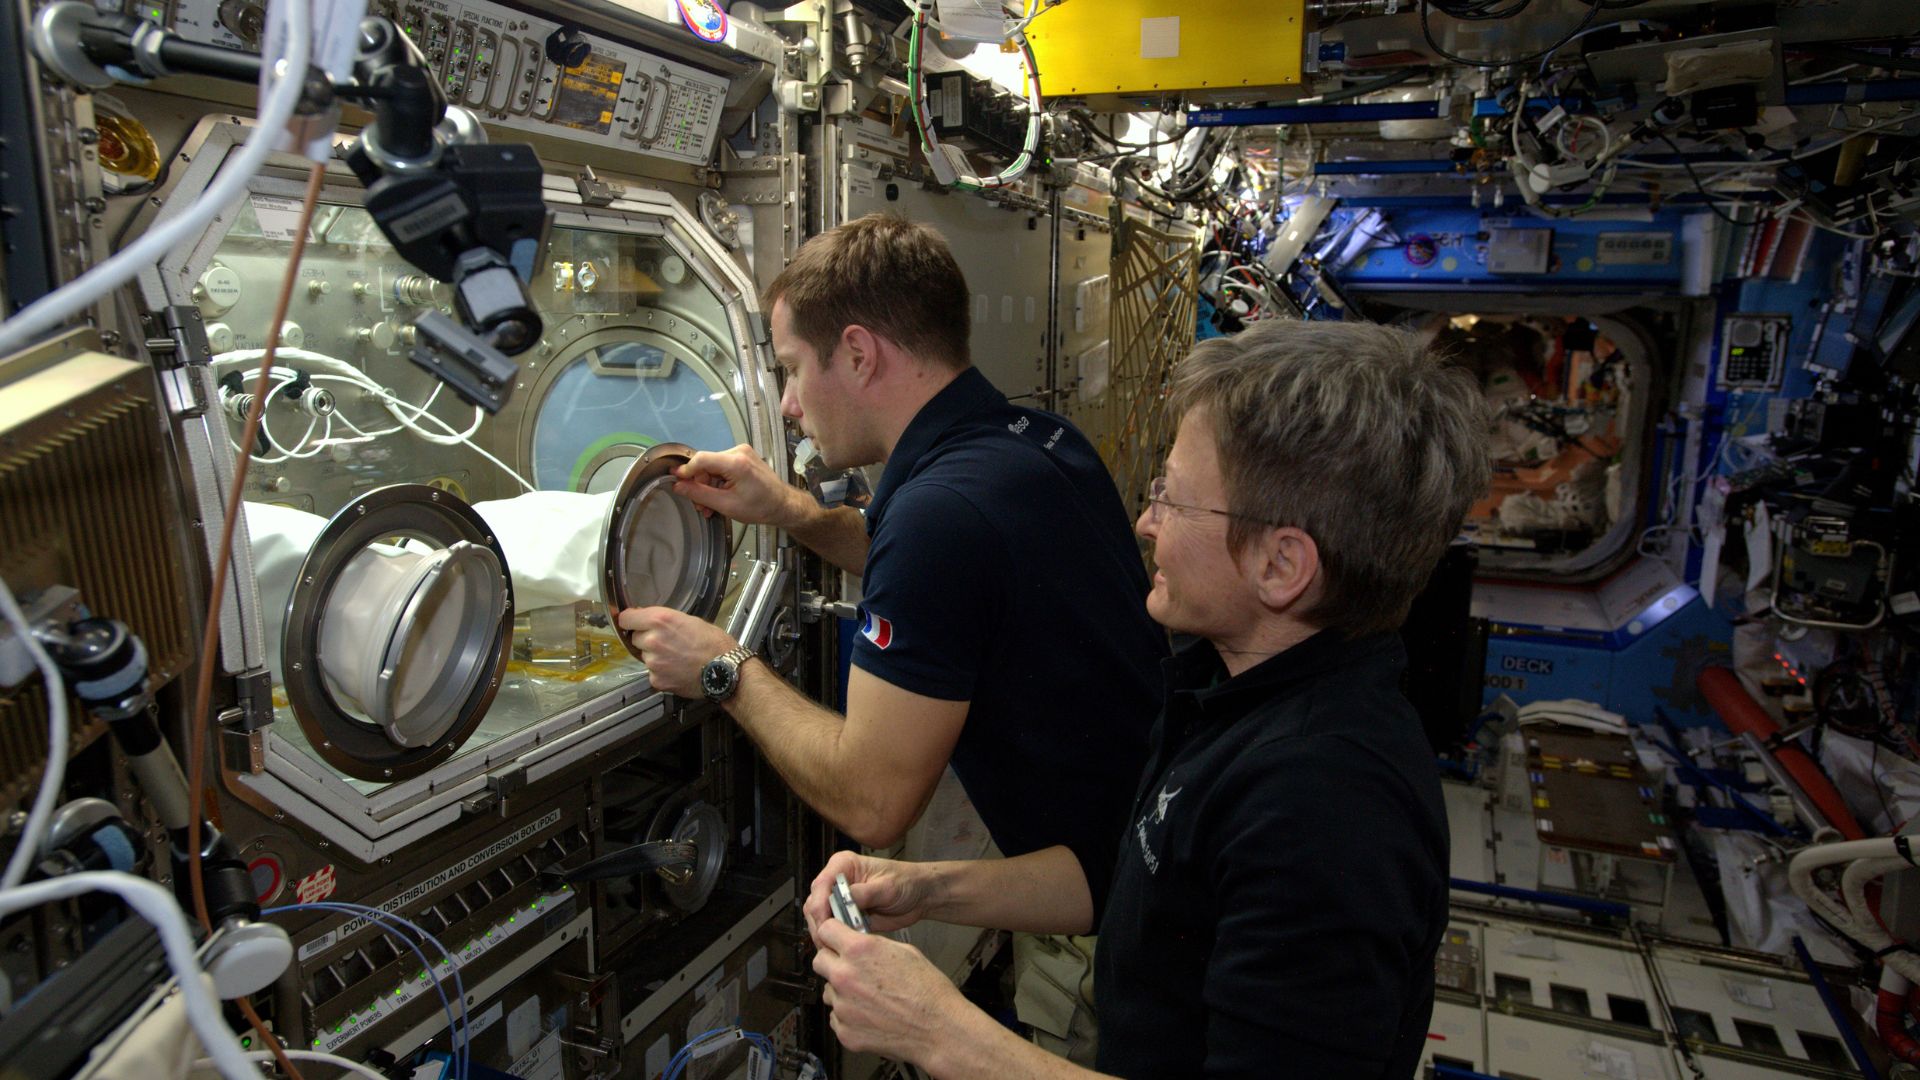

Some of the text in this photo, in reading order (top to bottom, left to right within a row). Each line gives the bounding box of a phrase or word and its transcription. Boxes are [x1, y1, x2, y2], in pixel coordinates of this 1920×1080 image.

[481, 15, 504, 29] FUNCTIONS
[1503, 656, 1552, 674] DECK
[343, 908, 381, 935] POWER
[383, 873, 447, 912] DISTRIBUTION
[447, 861, 466, 879] AND
[467, 832, 520, 867] CONVERSION
[520, 823, 537, 838] BOX
[326, 1010, 383, 1050] EXPERIMENT POWERS
